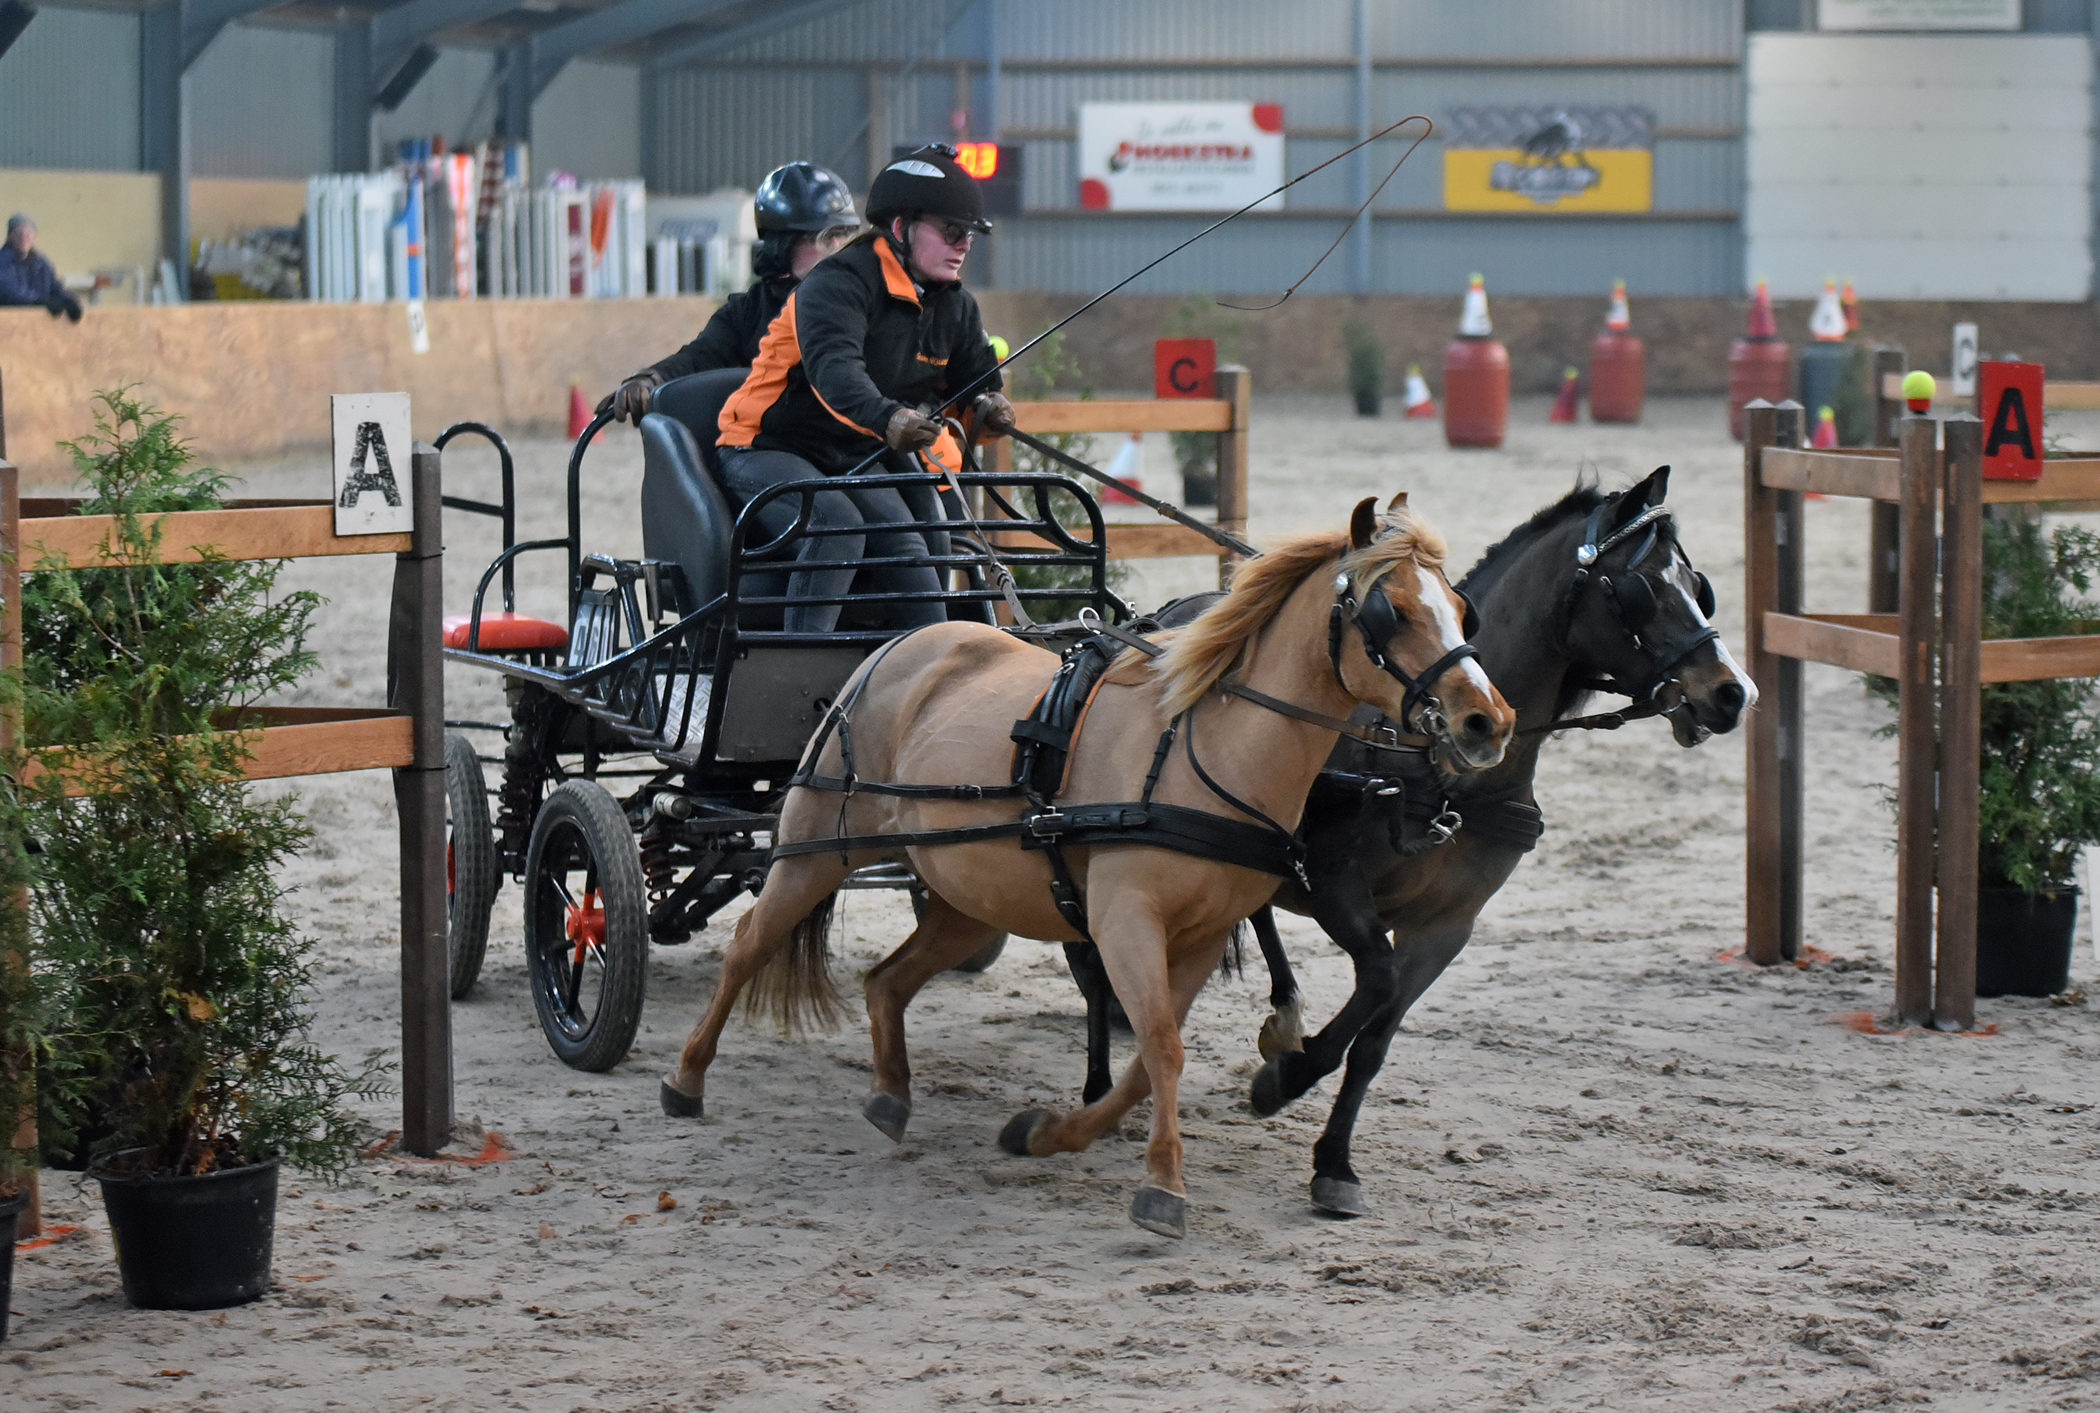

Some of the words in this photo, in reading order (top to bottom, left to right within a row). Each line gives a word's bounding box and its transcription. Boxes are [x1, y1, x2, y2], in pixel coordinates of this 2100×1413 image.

[1169, 357, 1199, 394] C
[1984, 387, 2036, 459] A
[338, 421, 403, 508] A
